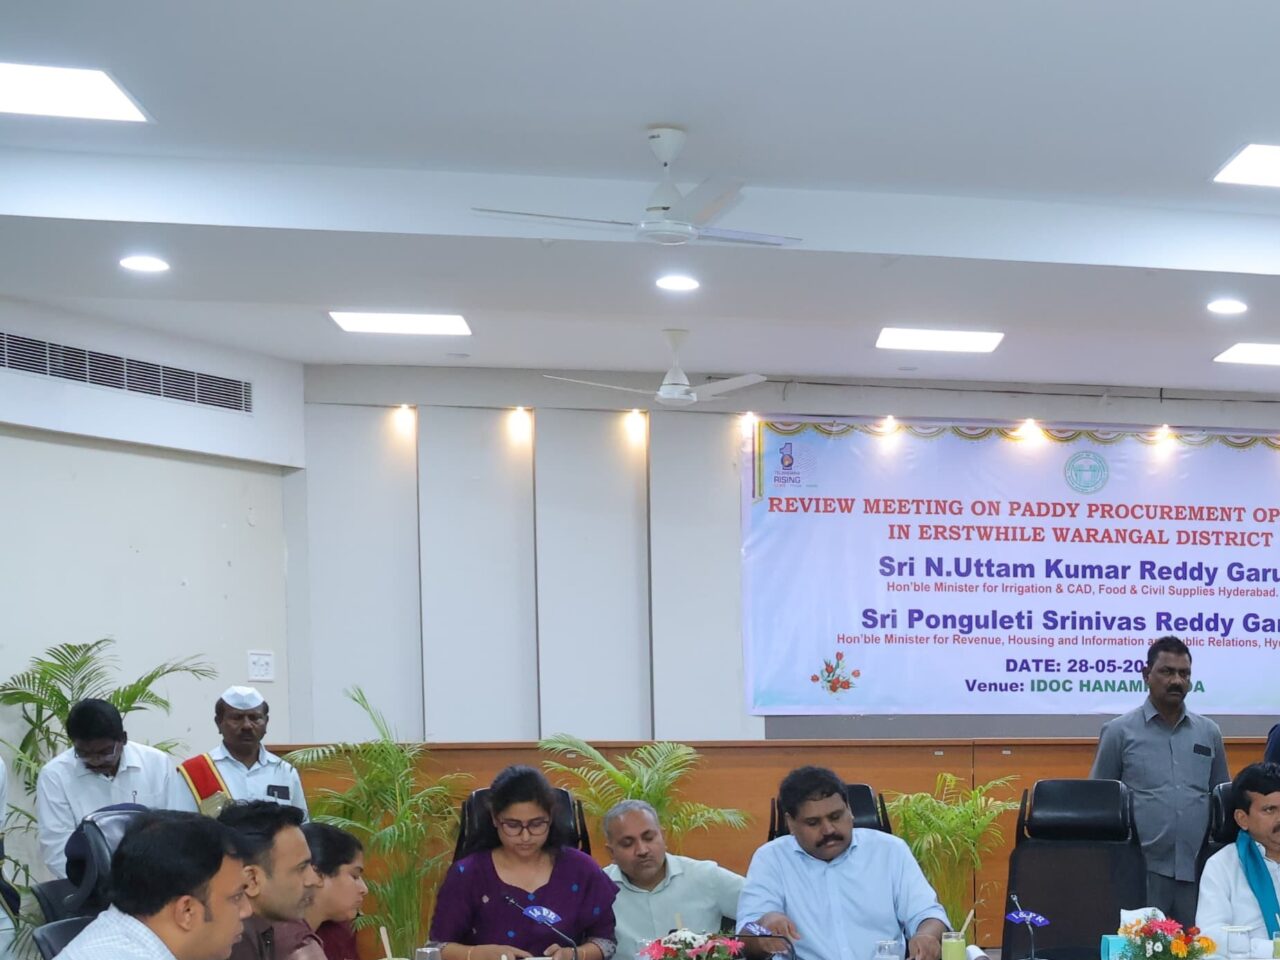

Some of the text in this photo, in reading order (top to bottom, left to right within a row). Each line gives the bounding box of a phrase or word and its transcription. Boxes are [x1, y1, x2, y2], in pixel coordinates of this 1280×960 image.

[768, 497, 855, 513] REVIEW
[863, 499, 964, 515] MEETING
[971, 501, 1001, 516] ON
[1008, 501, 1080, 518] PADDY
[1087, 504, 1246, 522] PROCUREMENT
[888, 524, 1273, 547] IN ERSTWHILE WARANGAL DISTRICT
[879, 556, 914, 576] Sri
[926, 557, 1035, 578] N.Uttam
[1045, 559, 1131, 579] Kumar
[1140, 561, 1218, 586] Reddy
[934, 583, 979, 592] Minister
[983, 583, 999, 592] for
[1002, 583, 1052, 595] Irrigation
[1055, 584, 1064, 594] &
[1067, 584, 1095, 595] CAD,
[1099, 585, 1126, 594] Food
[1130, 585, 1138, 595] &
[1141, 585, 1165, 595] Civil
[1168, 586, 1215, 598] Supplies
[1219, 587, 1278, 598] Hyderabad.
[862, 608, 897, 629] Sri
[908, 609, 1032, 634] Ponguleti
[1043, 610, 1146, 631] Srinivas
[1156, 612, 1234, 635] Reddy
[885, 634, 930, 644] Minister
[933, 635, 949, 644] for
[953, 635, 1004, 646] Revenue,
[1008, 636, 1054, 647] Housing
[1058, 636, 1078, 645] and
[1082, 636, 1144, 646] Information
[1208, 636, 1261, 648] Relations,
[1006, 659, 1149, 673] DATE: 28-05-20
[965, 679, 1205, 693] Venue: IDOC HANAMA
